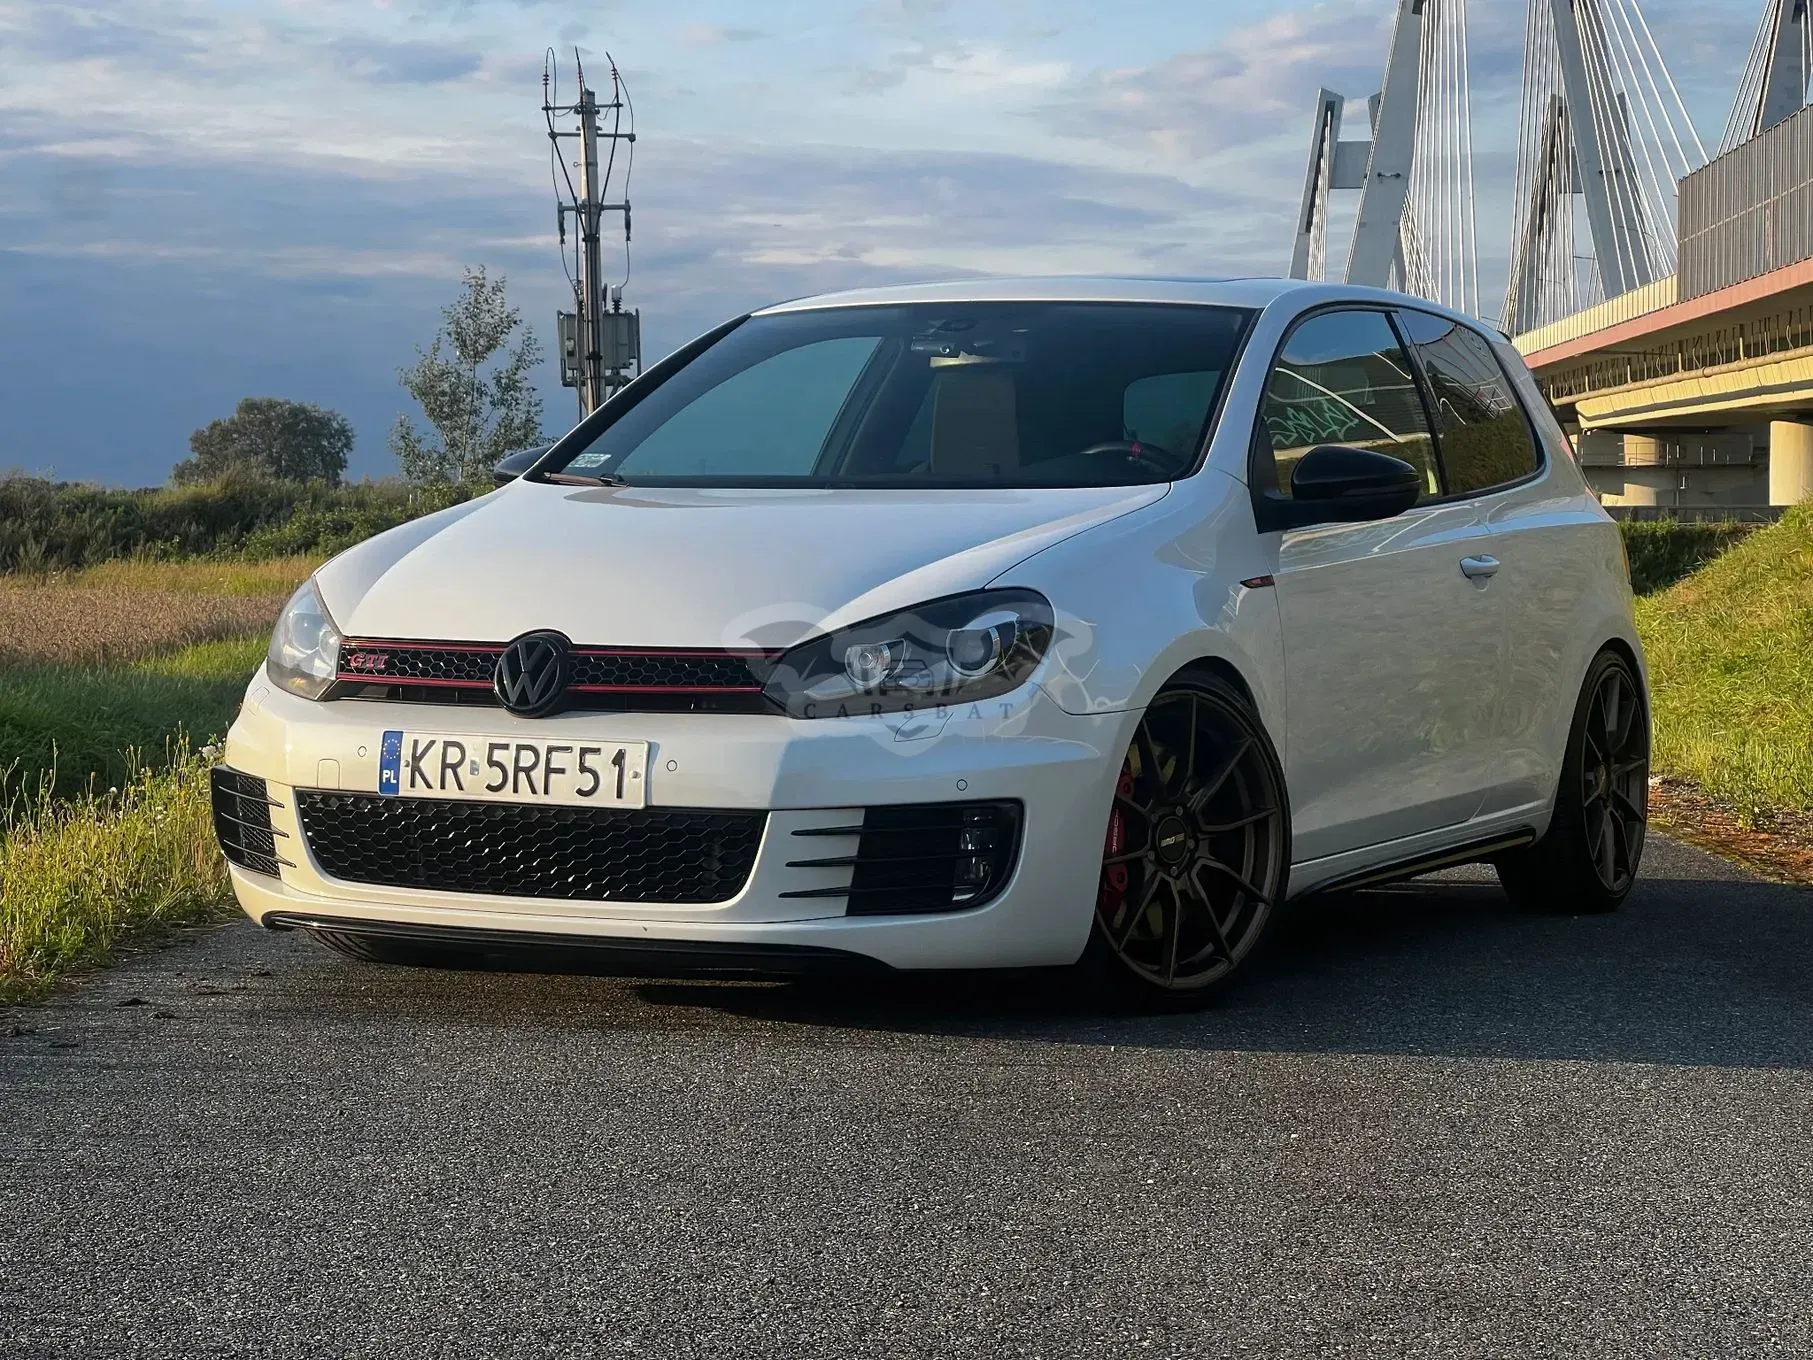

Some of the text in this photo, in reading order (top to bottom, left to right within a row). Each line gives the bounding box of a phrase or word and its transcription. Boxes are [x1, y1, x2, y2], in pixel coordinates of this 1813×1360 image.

[350, 652, 389, 668] GTI
[382, 769, 397, 783] PL
[409, 739, 626, 799] KR 5RF51
